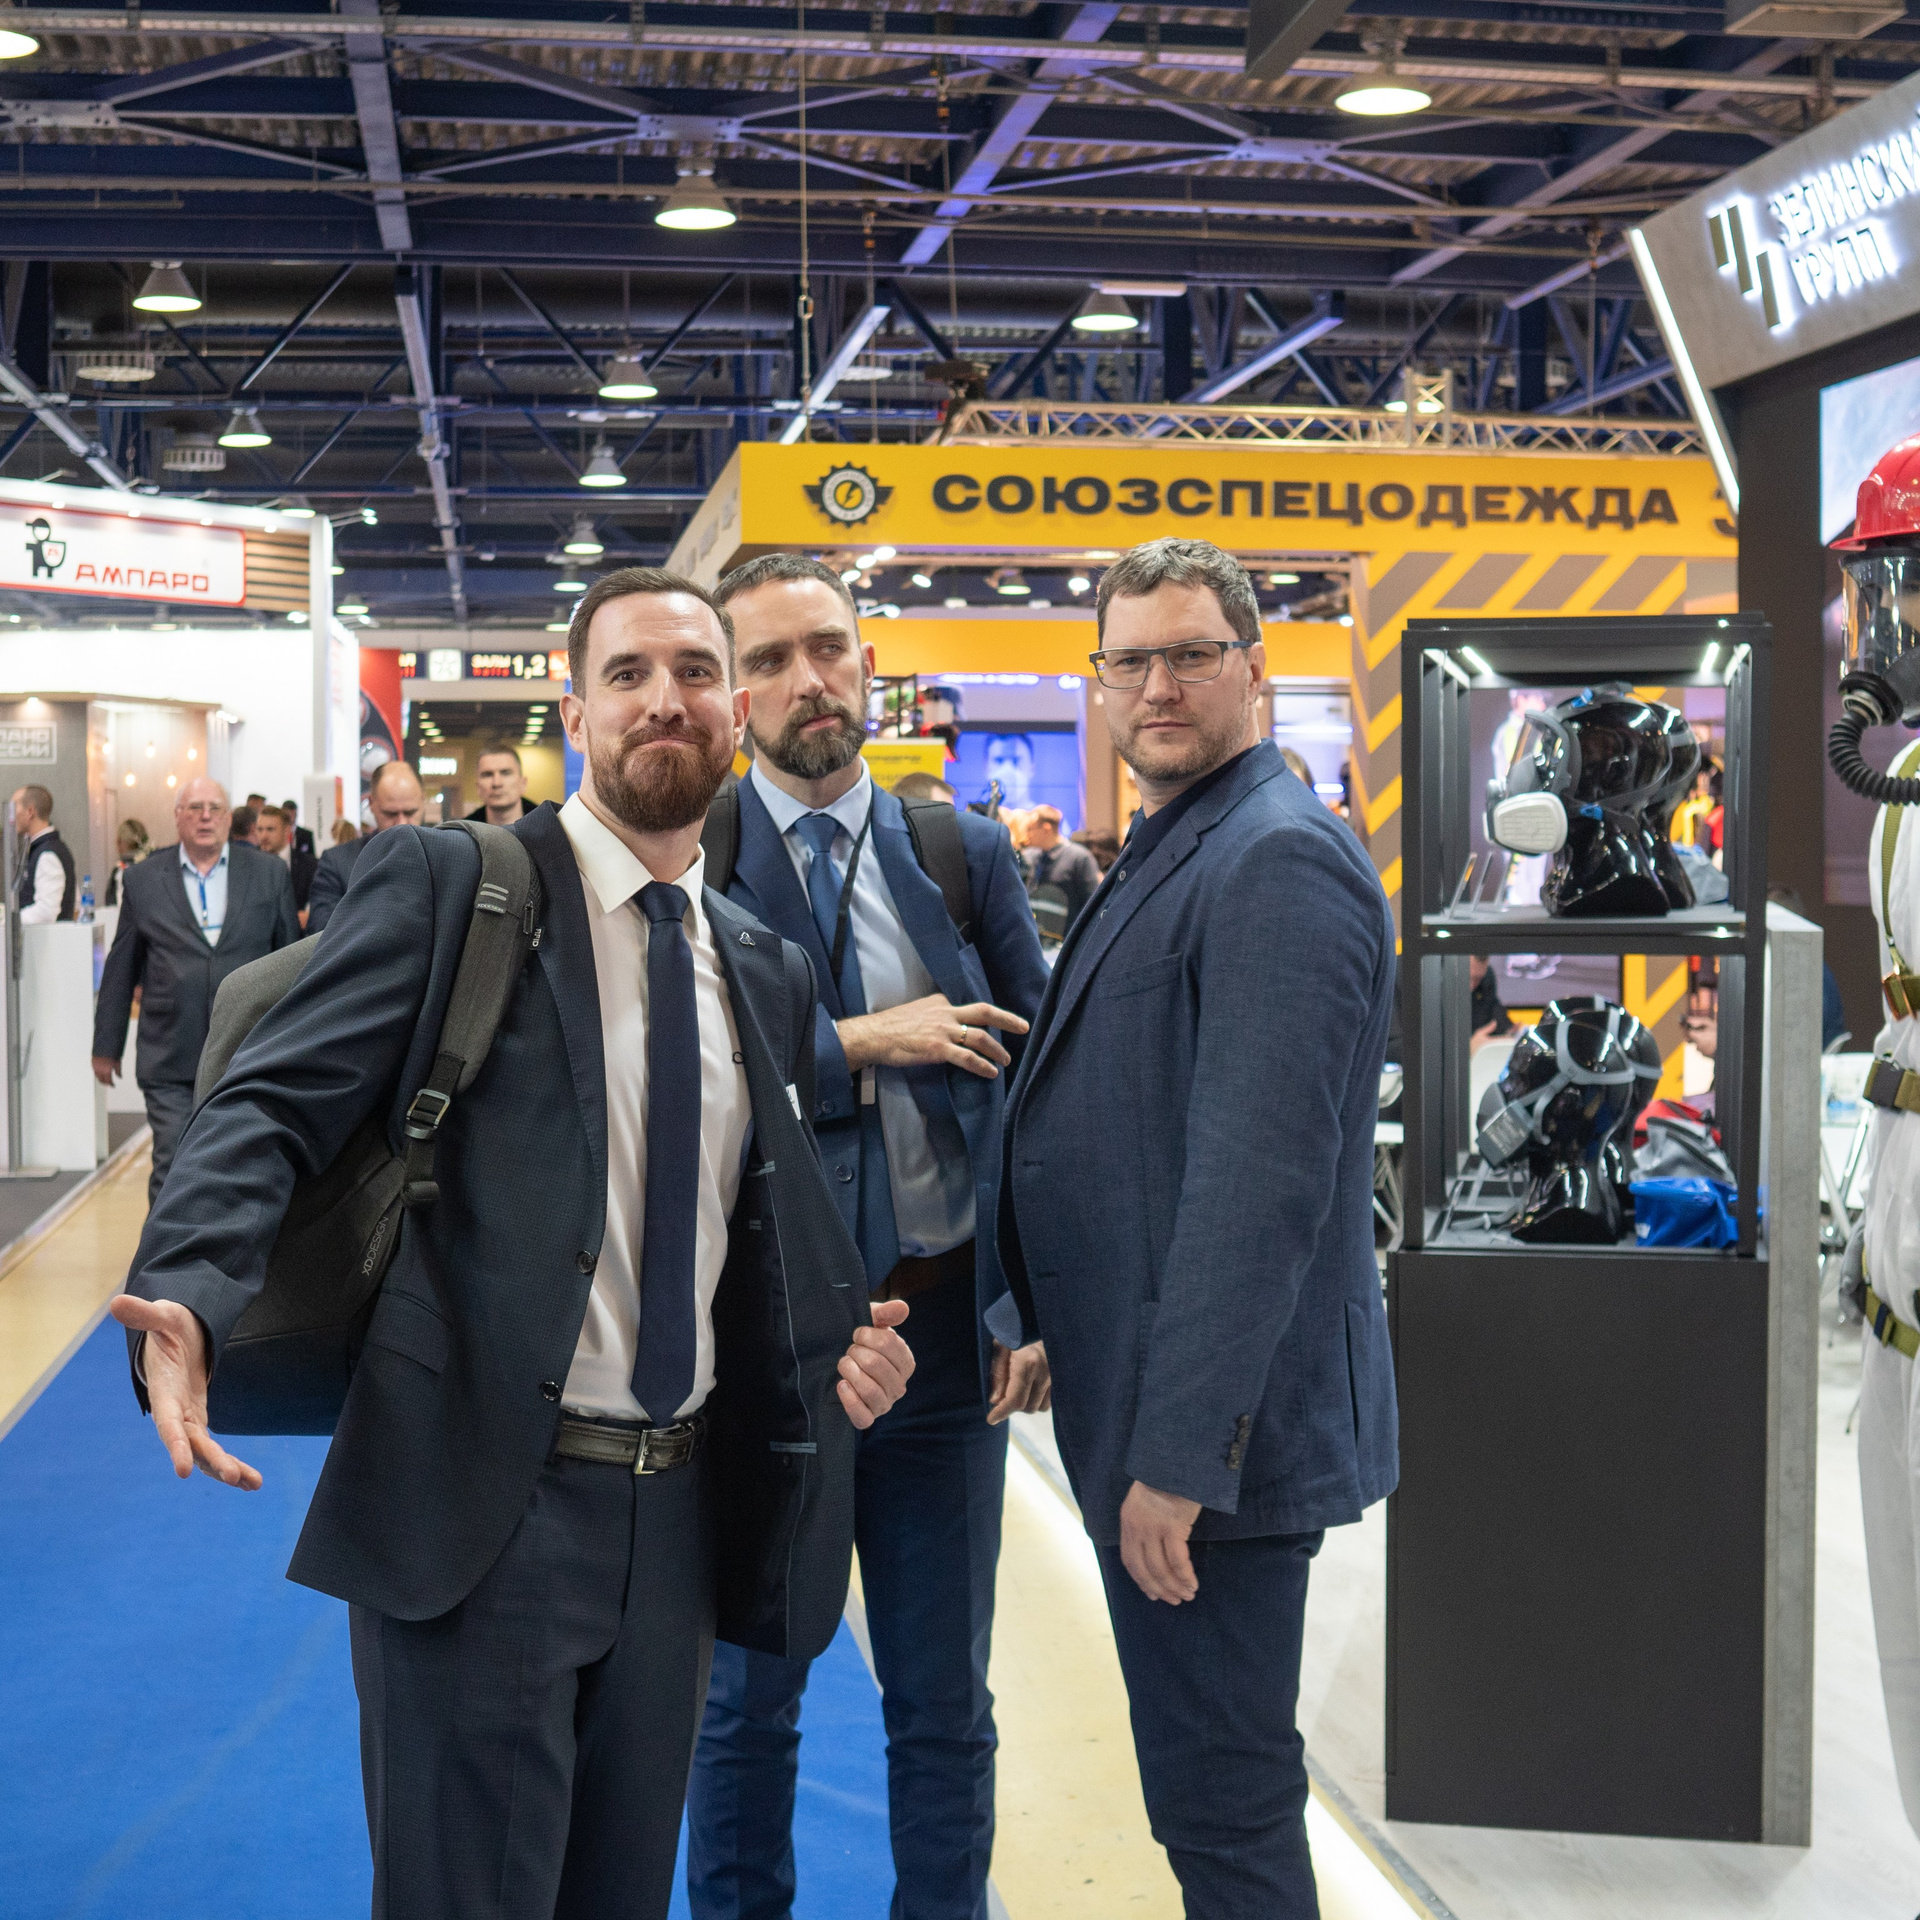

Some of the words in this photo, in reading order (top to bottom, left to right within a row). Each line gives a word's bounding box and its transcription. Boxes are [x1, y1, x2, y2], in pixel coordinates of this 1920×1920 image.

[1767, 116, 1920, 247] ЗЕЛИНСКИ
[1787, 226, 1890, 304] ГРУПП
[931, 474, 1678, 530] СОЮЗСПЕЦОДЕЖДА
[75, 563, 208, 592] АМПАРО
[511, 654, 546, 680] 1,2
